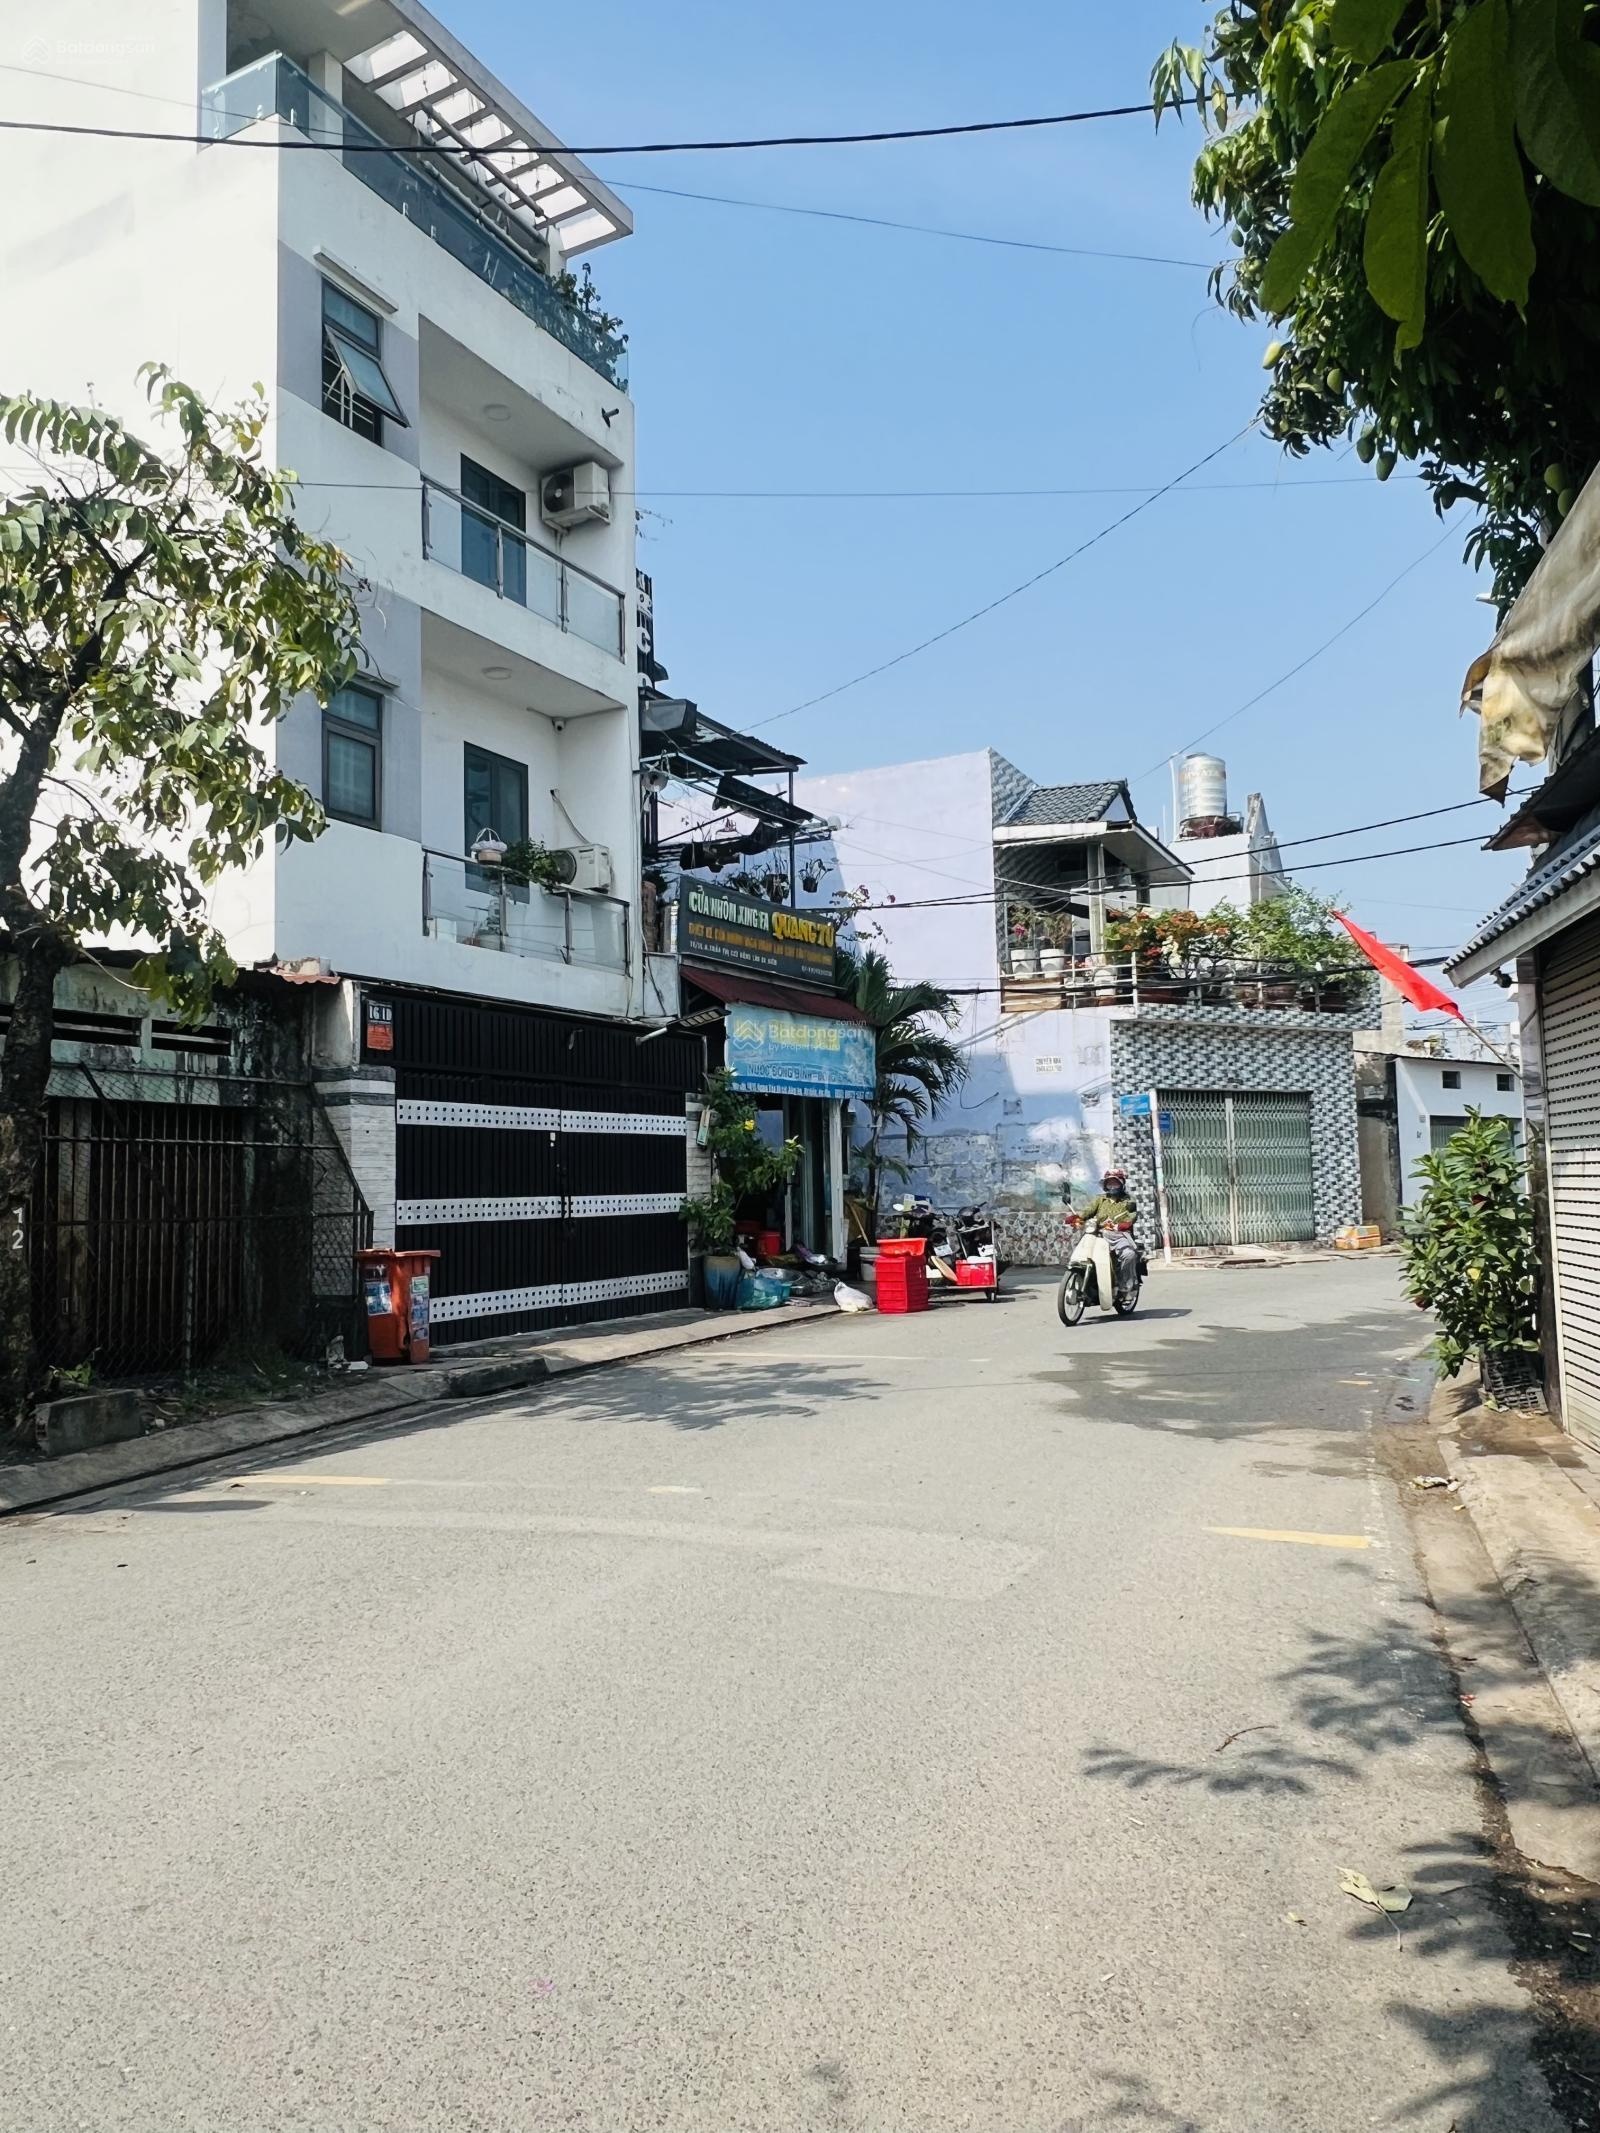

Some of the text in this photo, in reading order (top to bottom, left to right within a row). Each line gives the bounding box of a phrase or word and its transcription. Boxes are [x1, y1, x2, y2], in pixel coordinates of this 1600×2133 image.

[689, 885, 709, 915] CỬA
[710, 896, 736, 923] NHÔM
[772, 911, 817, 943] QUANG
[817, 921, 834, 948] TÚ
